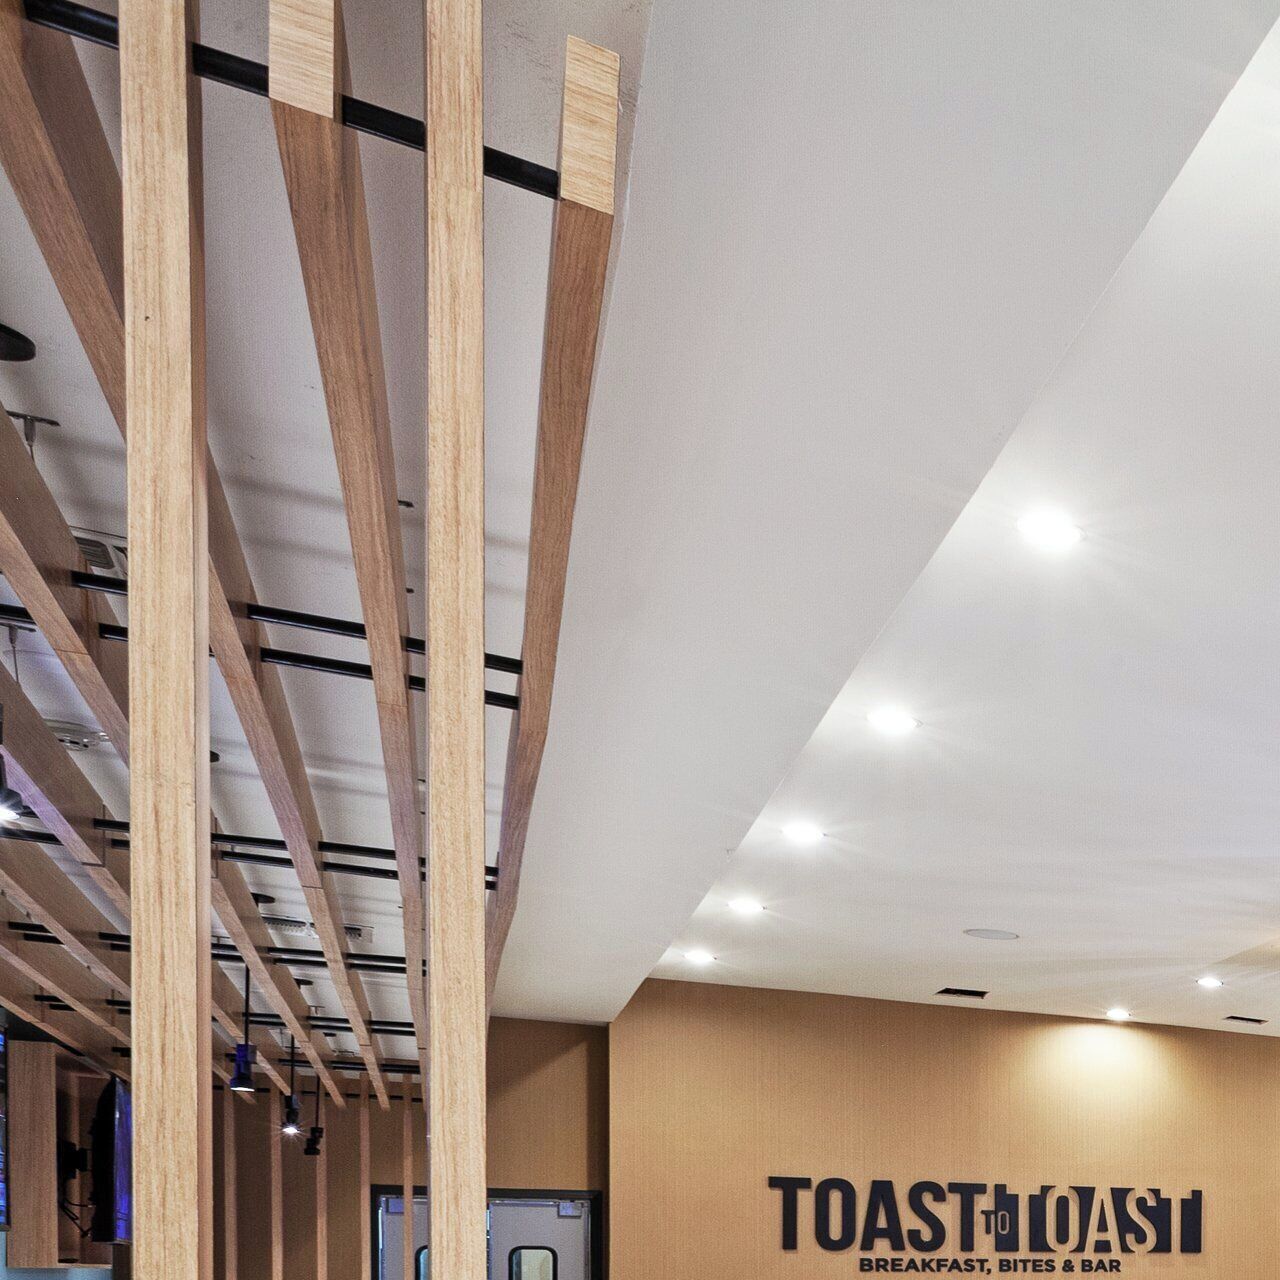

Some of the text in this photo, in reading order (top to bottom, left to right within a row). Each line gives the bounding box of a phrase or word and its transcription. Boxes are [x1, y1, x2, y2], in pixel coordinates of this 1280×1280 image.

[768, 1176, 1203, 1254] TOAST TO TOAST
[859, 1257, 1122, 1276] BREAKFAST, BITES & BAR
